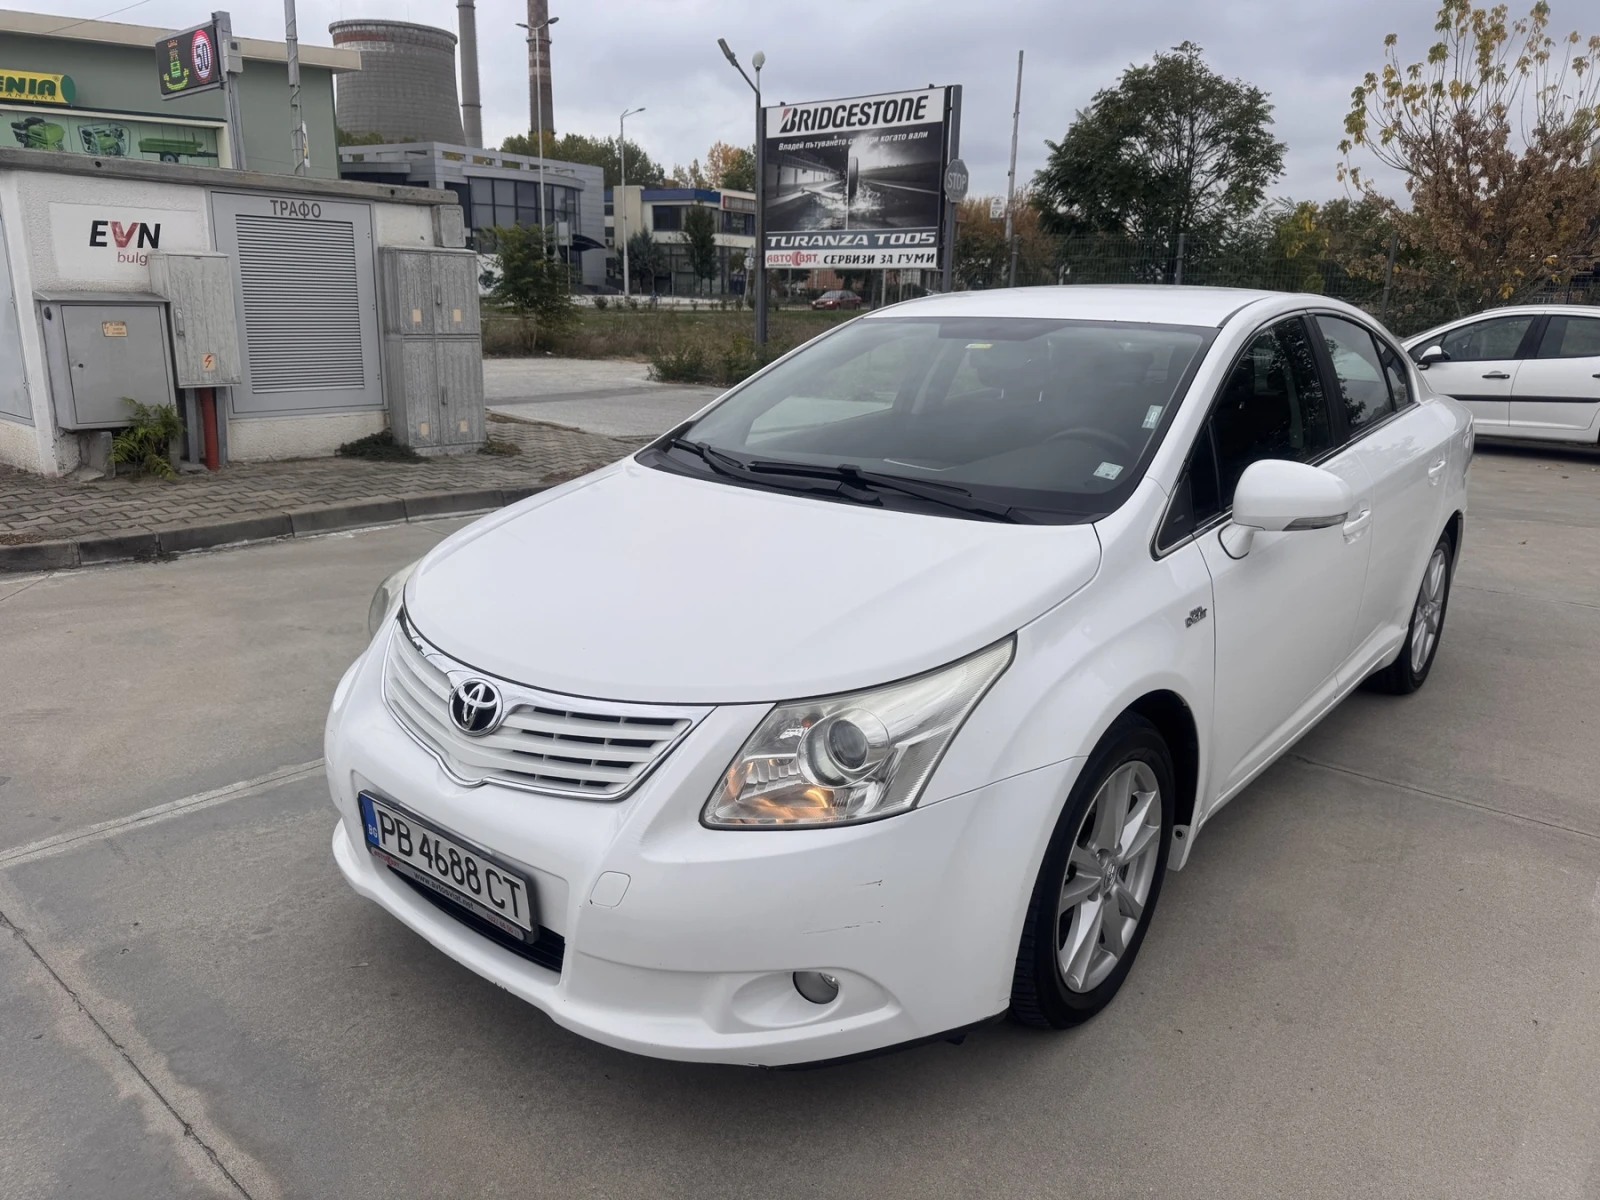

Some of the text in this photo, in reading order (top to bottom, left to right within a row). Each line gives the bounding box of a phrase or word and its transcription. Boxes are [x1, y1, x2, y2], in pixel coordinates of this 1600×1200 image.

[195, 43, 210, 72] 50
[779, 95, 929, 134] BRIDGESTONE
[778, 140, 804, 151] Владей
[805, 138, 847, 149] пътуването
[880, 134, 907, 143] когато
[908, 131, 929, 140] вали
[947, 172, 967, 190] STOP
[270, 199, 322, 219] ТРАФО
[89, 220, 161, 249] EVN
[767, 234, 869, 247] TURANZA
[823, 254, 875, 265] СЕРВИЗИ
[880, 254, 893, 264] ЗА
[898, 253, 936, 264] ГУМИ
[368, 824, 378, 838] BG
[377, 810, 521, 919] PB 4688 CT
